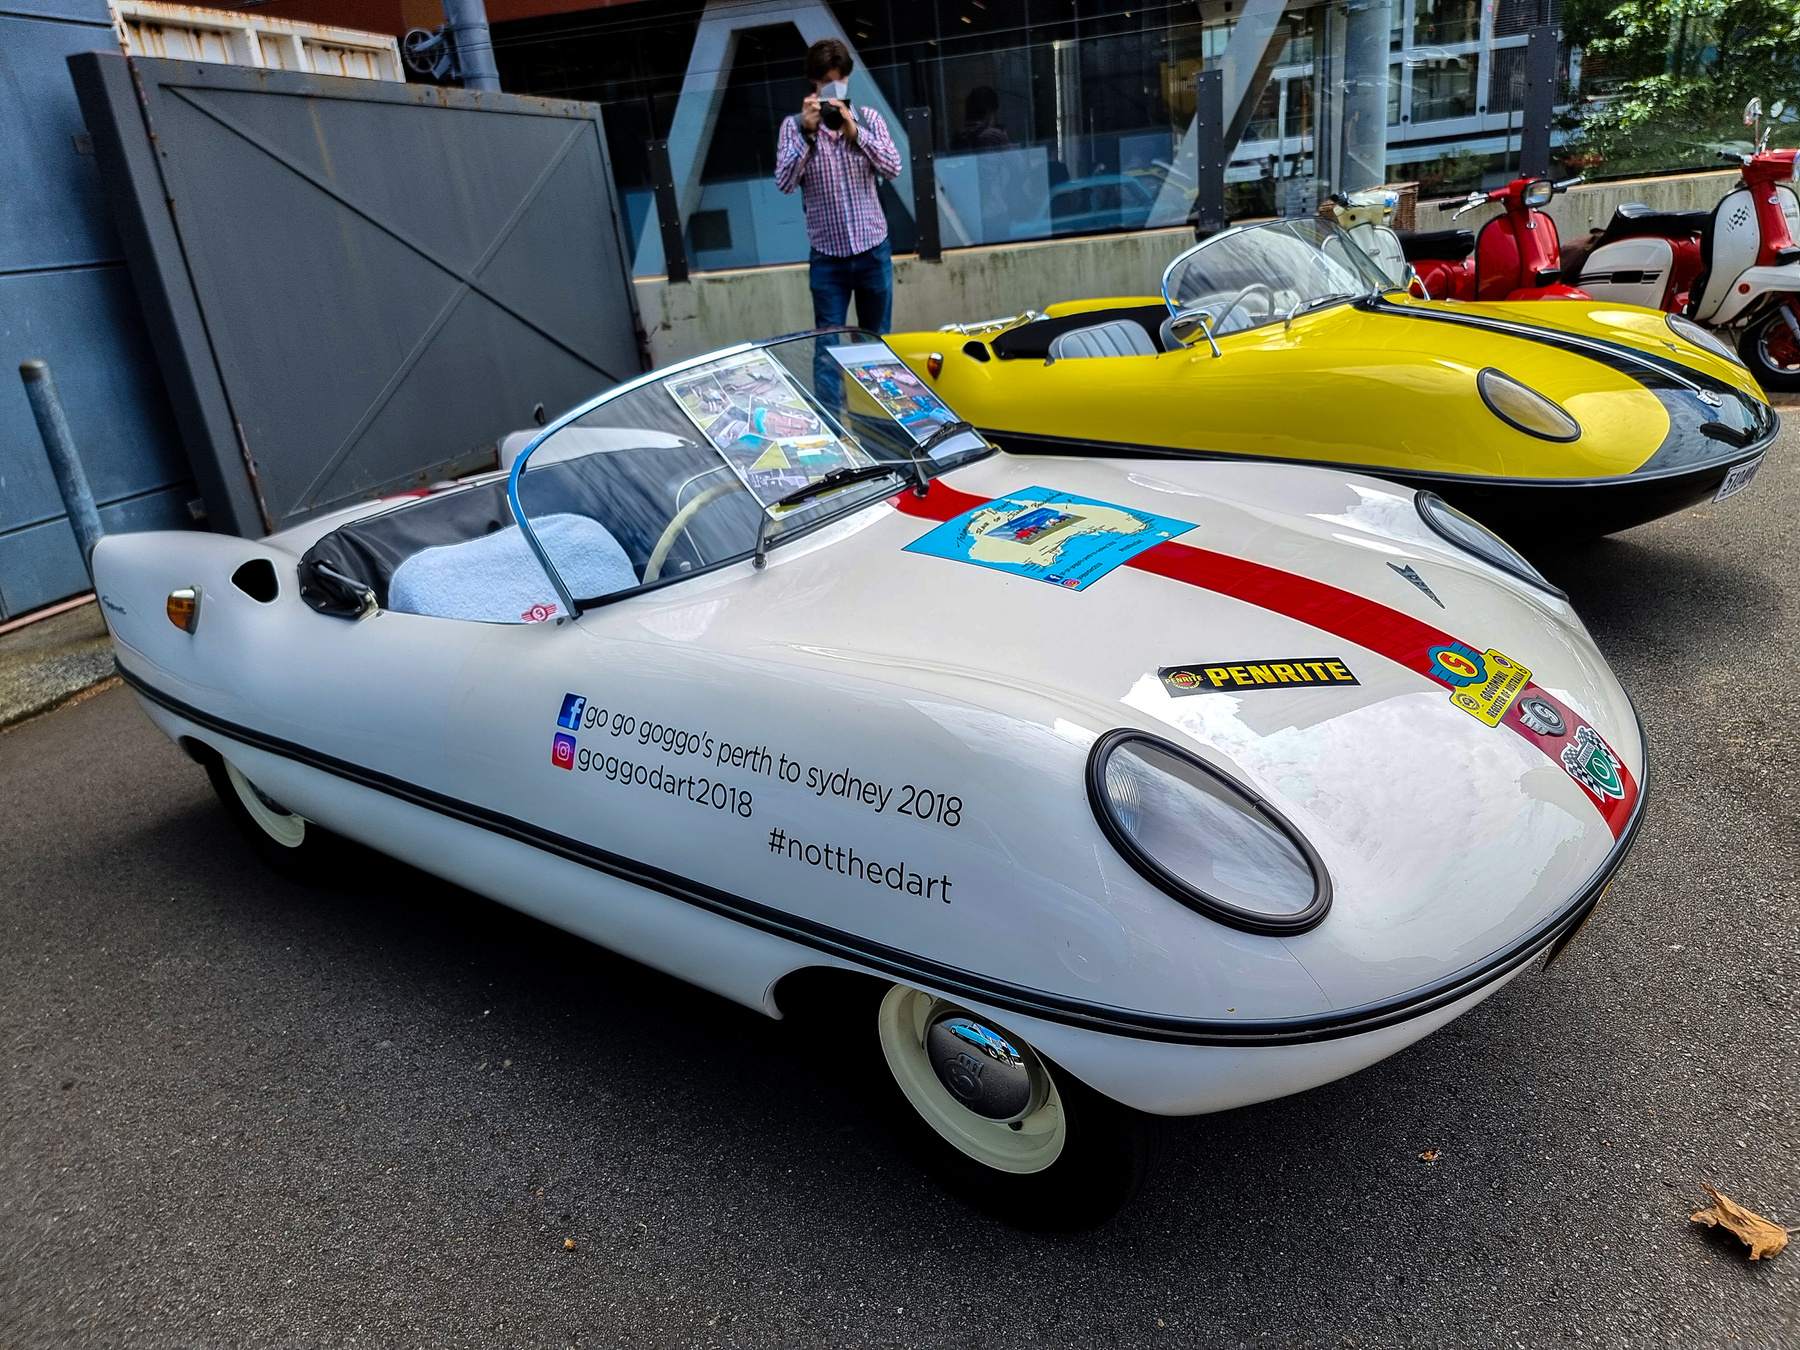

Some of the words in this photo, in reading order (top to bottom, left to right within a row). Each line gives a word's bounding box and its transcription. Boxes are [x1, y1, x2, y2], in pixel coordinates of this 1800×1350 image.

[1164, 674, 1204, 686] PENRITE
[1203, 661, 1354, 688] PENRITE
[1504, 671, 1526, 694] AUSTRALIA
[1500, 689, 1512, 699] OF
[1486, 695, 1508, 719] REGISTER
[584, 703, 609, 731] go
[611, 711, 636, 738] go
[637, 720, 715, 759] goggo's
[716, 740, 773, 777] perth
[777, 753, 802, 784] to
[805, 766, 894, 814] sydney
[896, 783, 964, 828] 2018
[577, 745, 755, 820] goggodart2018
[767, 825, 954, 905] #notthedart
